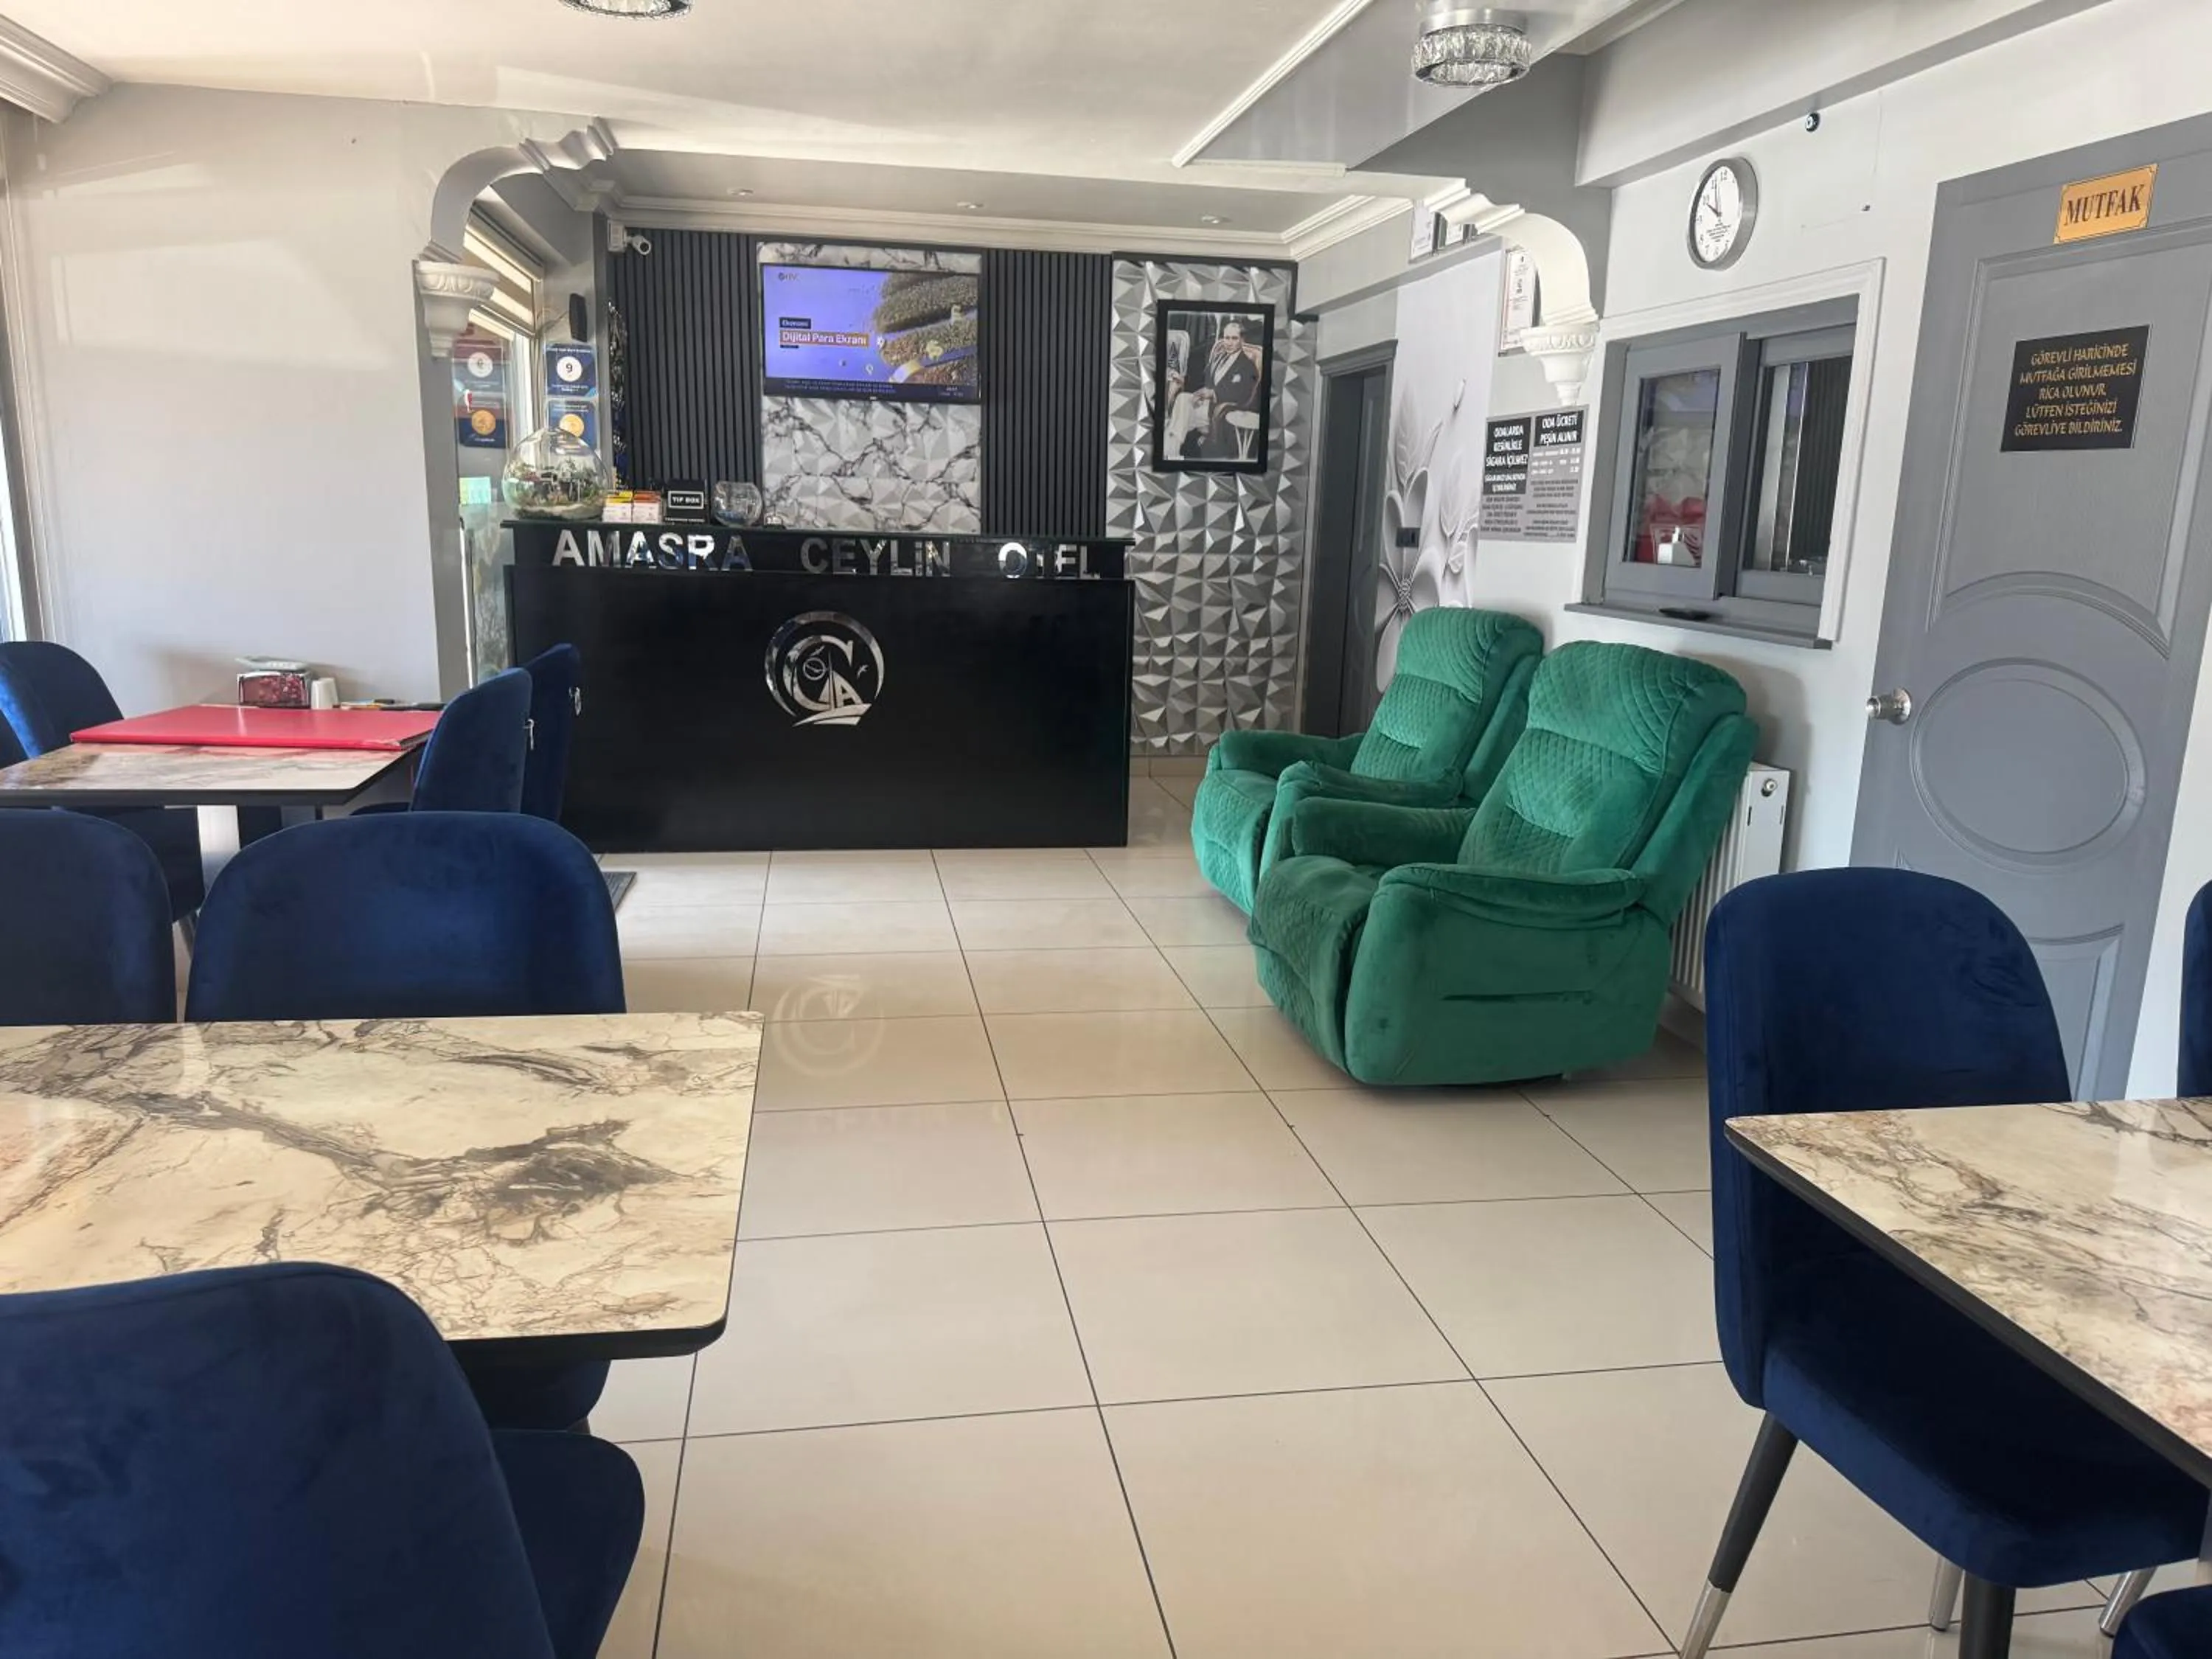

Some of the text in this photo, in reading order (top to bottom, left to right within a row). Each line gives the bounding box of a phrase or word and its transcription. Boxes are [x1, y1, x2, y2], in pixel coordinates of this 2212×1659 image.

[2064, 184, 2145, 226] MUTFAK
[782, 331, 810, 343] Dijital
[812, 333, 834, 343] Para
[2031, 347, 2072, 366] GÖREVLİ
[2020, 367, 2065, 385] MUTFAĞA
[552, 529, 753, 571] AMASRA
